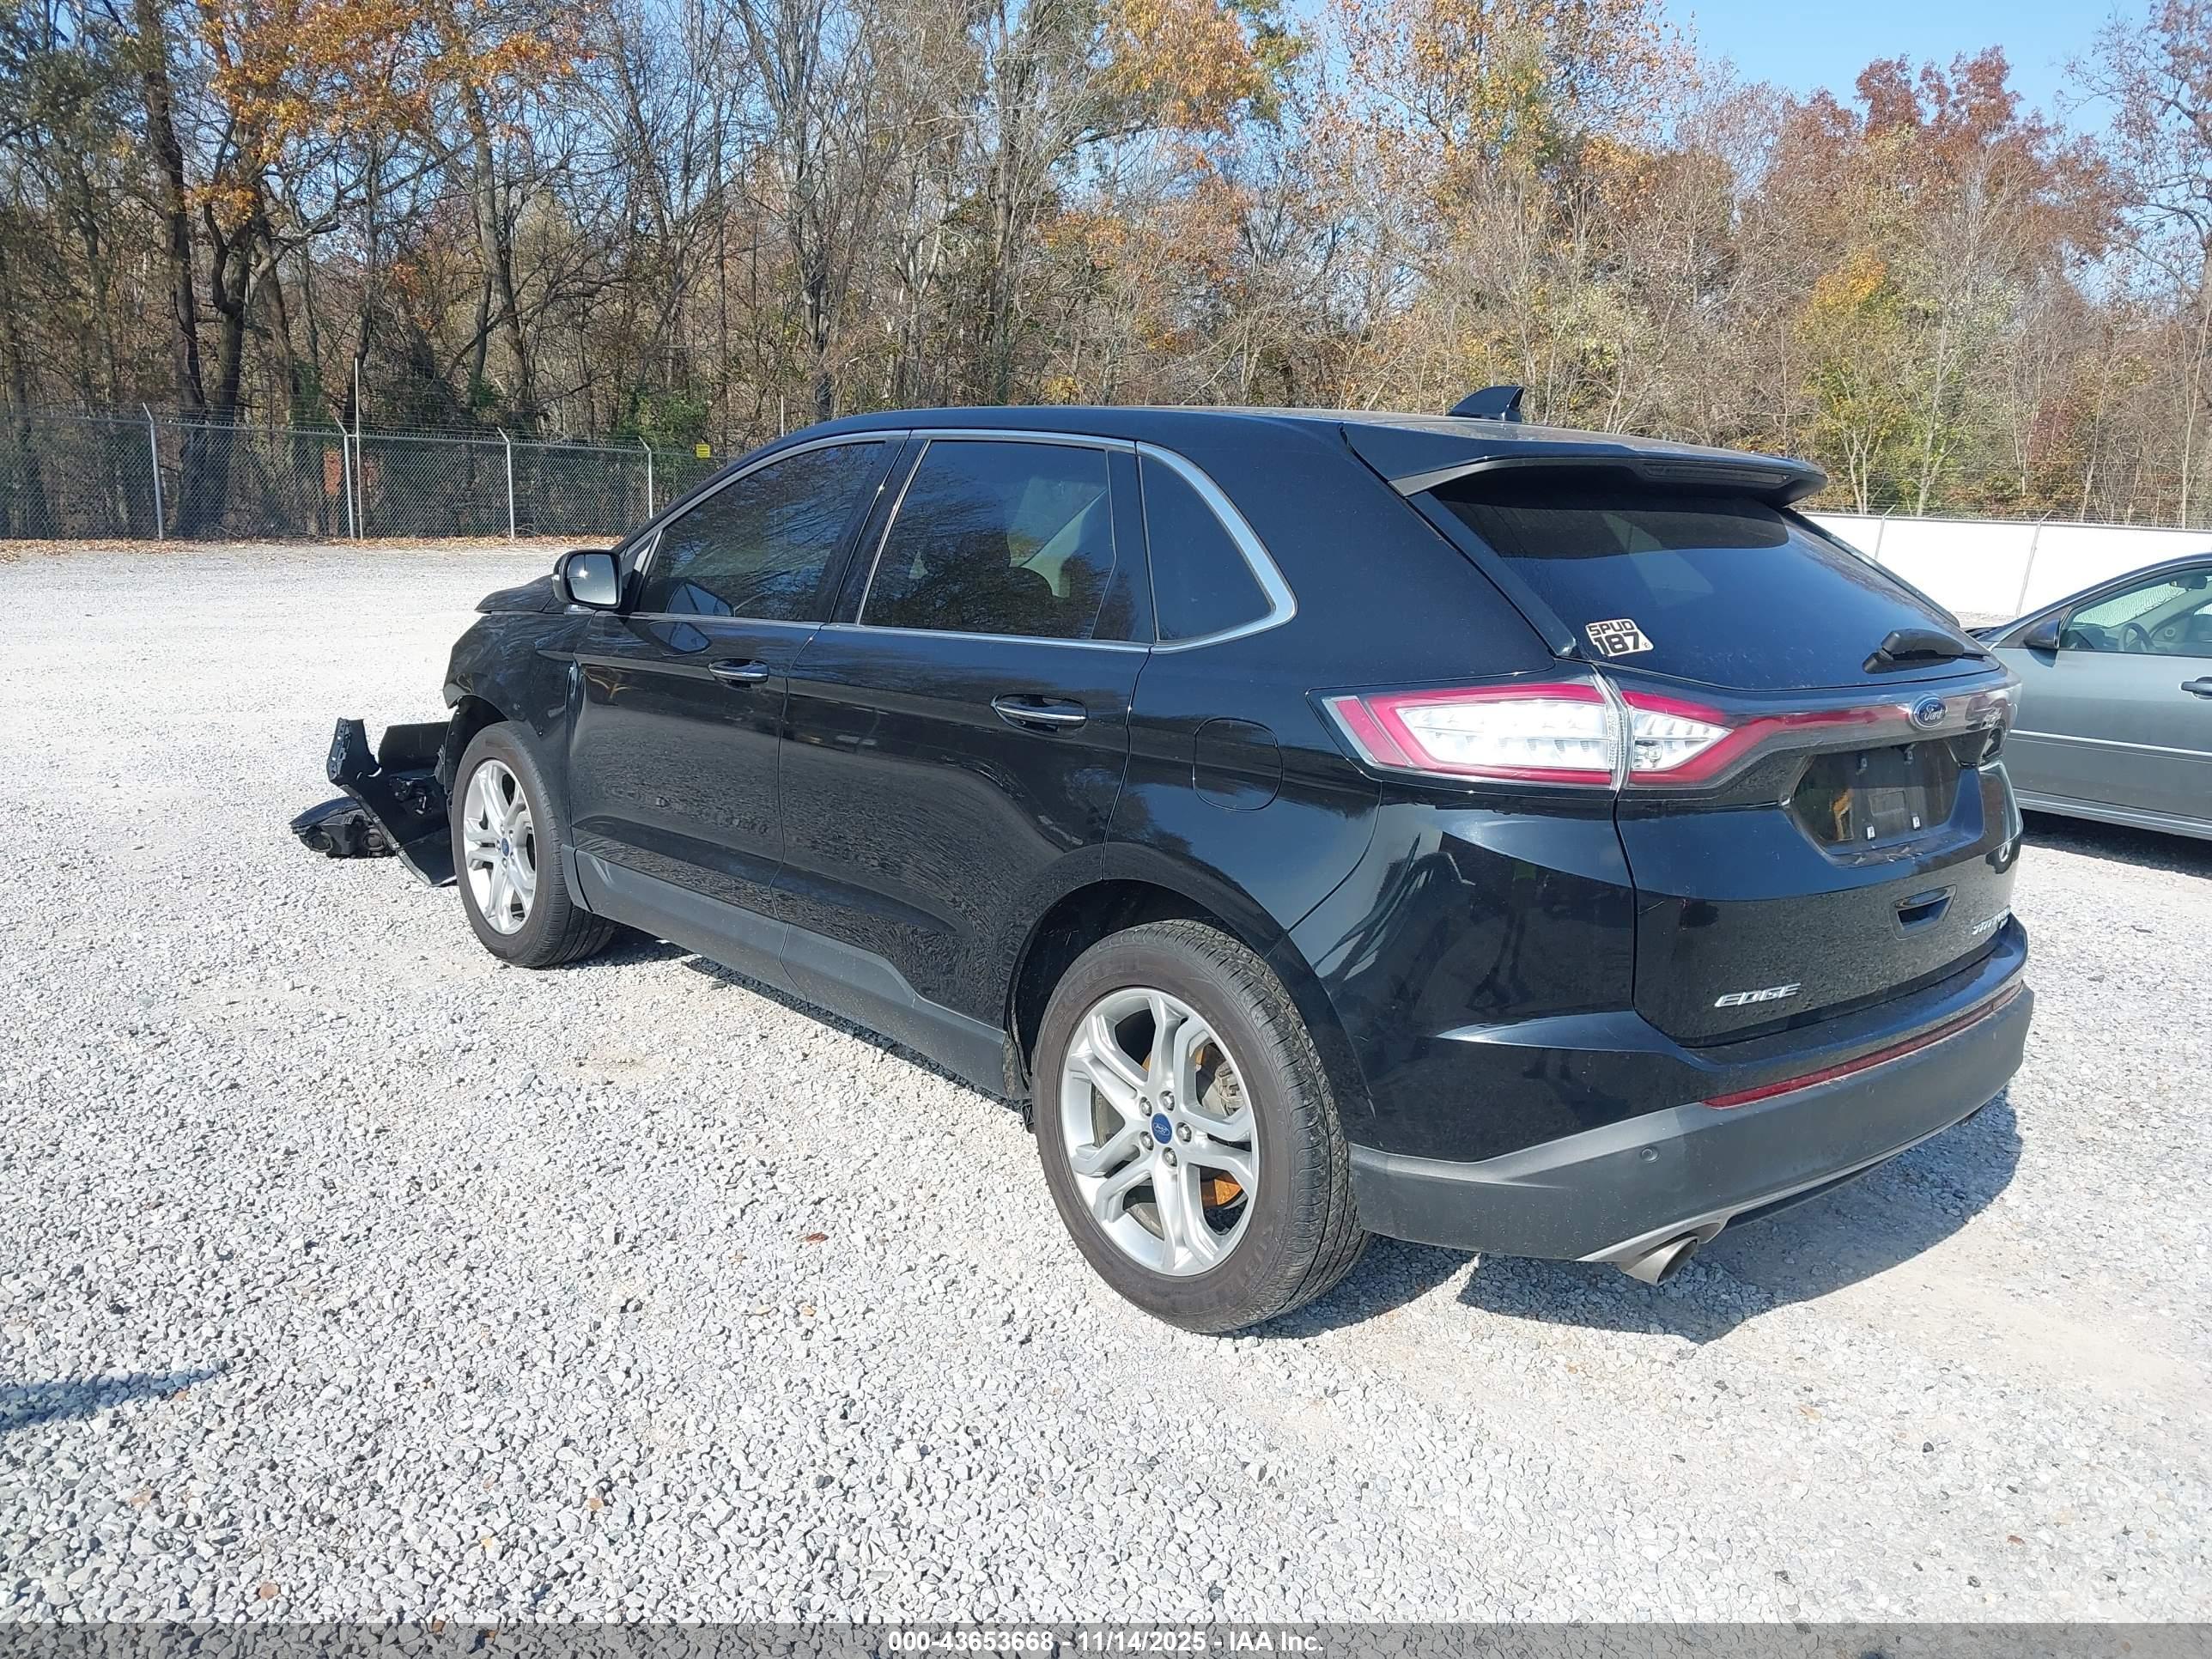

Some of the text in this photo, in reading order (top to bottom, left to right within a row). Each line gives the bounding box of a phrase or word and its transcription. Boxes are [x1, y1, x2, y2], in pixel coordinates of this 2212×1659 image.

[1588, 621, 1635, 636] SPUD
[1593, 631, 1639, 654] 187
[1923, 704, 1946, 721] Ford
[1715, 982, 1802, 1007] EDGE
